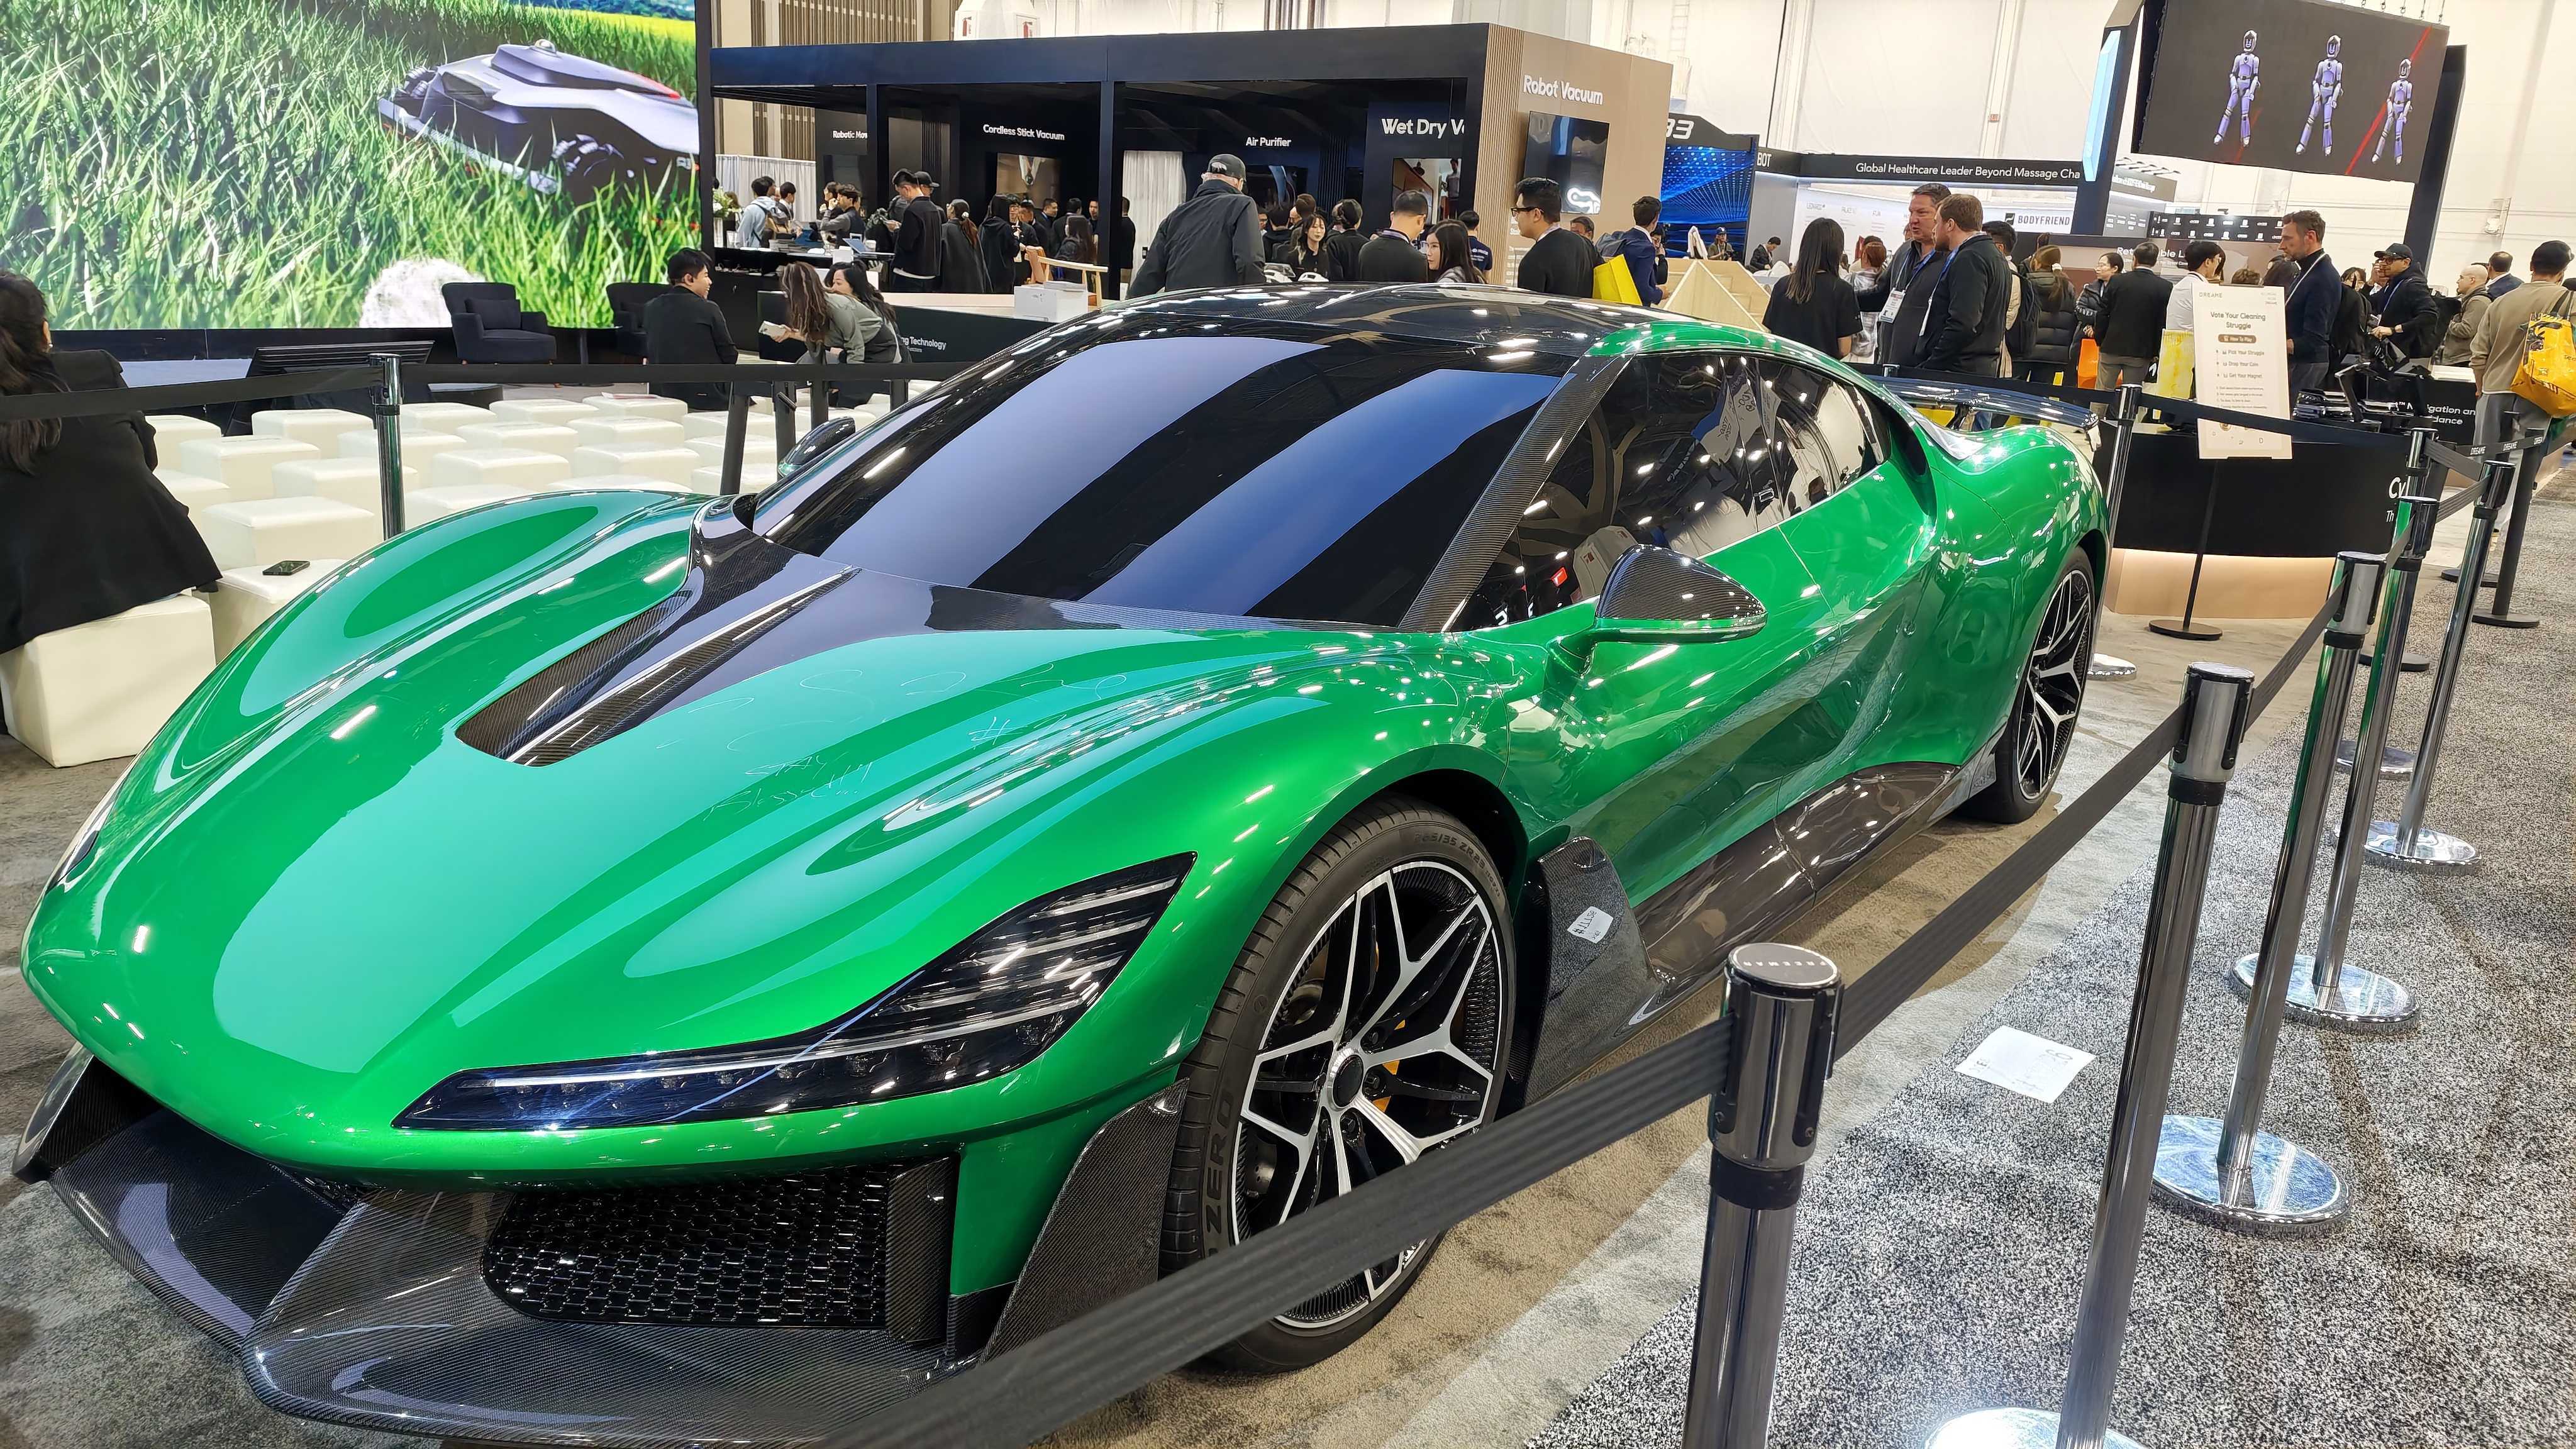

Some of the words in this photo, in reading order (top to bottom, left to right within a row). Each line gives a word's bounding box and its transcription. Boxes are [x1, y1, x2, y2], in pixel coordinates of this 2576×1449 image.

[1523, 74, 1558, 98] Robot
[1560, 80, 1603, 105] Vacuum
[833, 130, 855, 139] Robotic
[983, 124, 1016, 136] Cordless
[1016, 127, 1035, 138] Stick
[1036, 129, 1065, 141] Vacuum
[1381, 118, 1413, 135] Wet
[1416, 119, 1447, 139] Dry
[1245, 136, 1258, 146] Air
[1260, 136, 1292, 147] Purifier
[1757, 152, 1772, 167] BOT
[1855, 162, 1886, 173] Global
[1888, 164, 1938, 175] Healthcare
[1940, 165, 1973, 175] Leader
[1975, 166, 2012, 178] Beyond
[2014, 167, 2058, 180] Massage
[2018, 215, 2070, 226] BODYFRIEND
[2240, 313, 2266, 322] Cleaning
[2226, 321, 2251, 330] Struggle
[910, 336, 947, 350] Technology
[1206, 1090, 1234, 1235] ZERO
